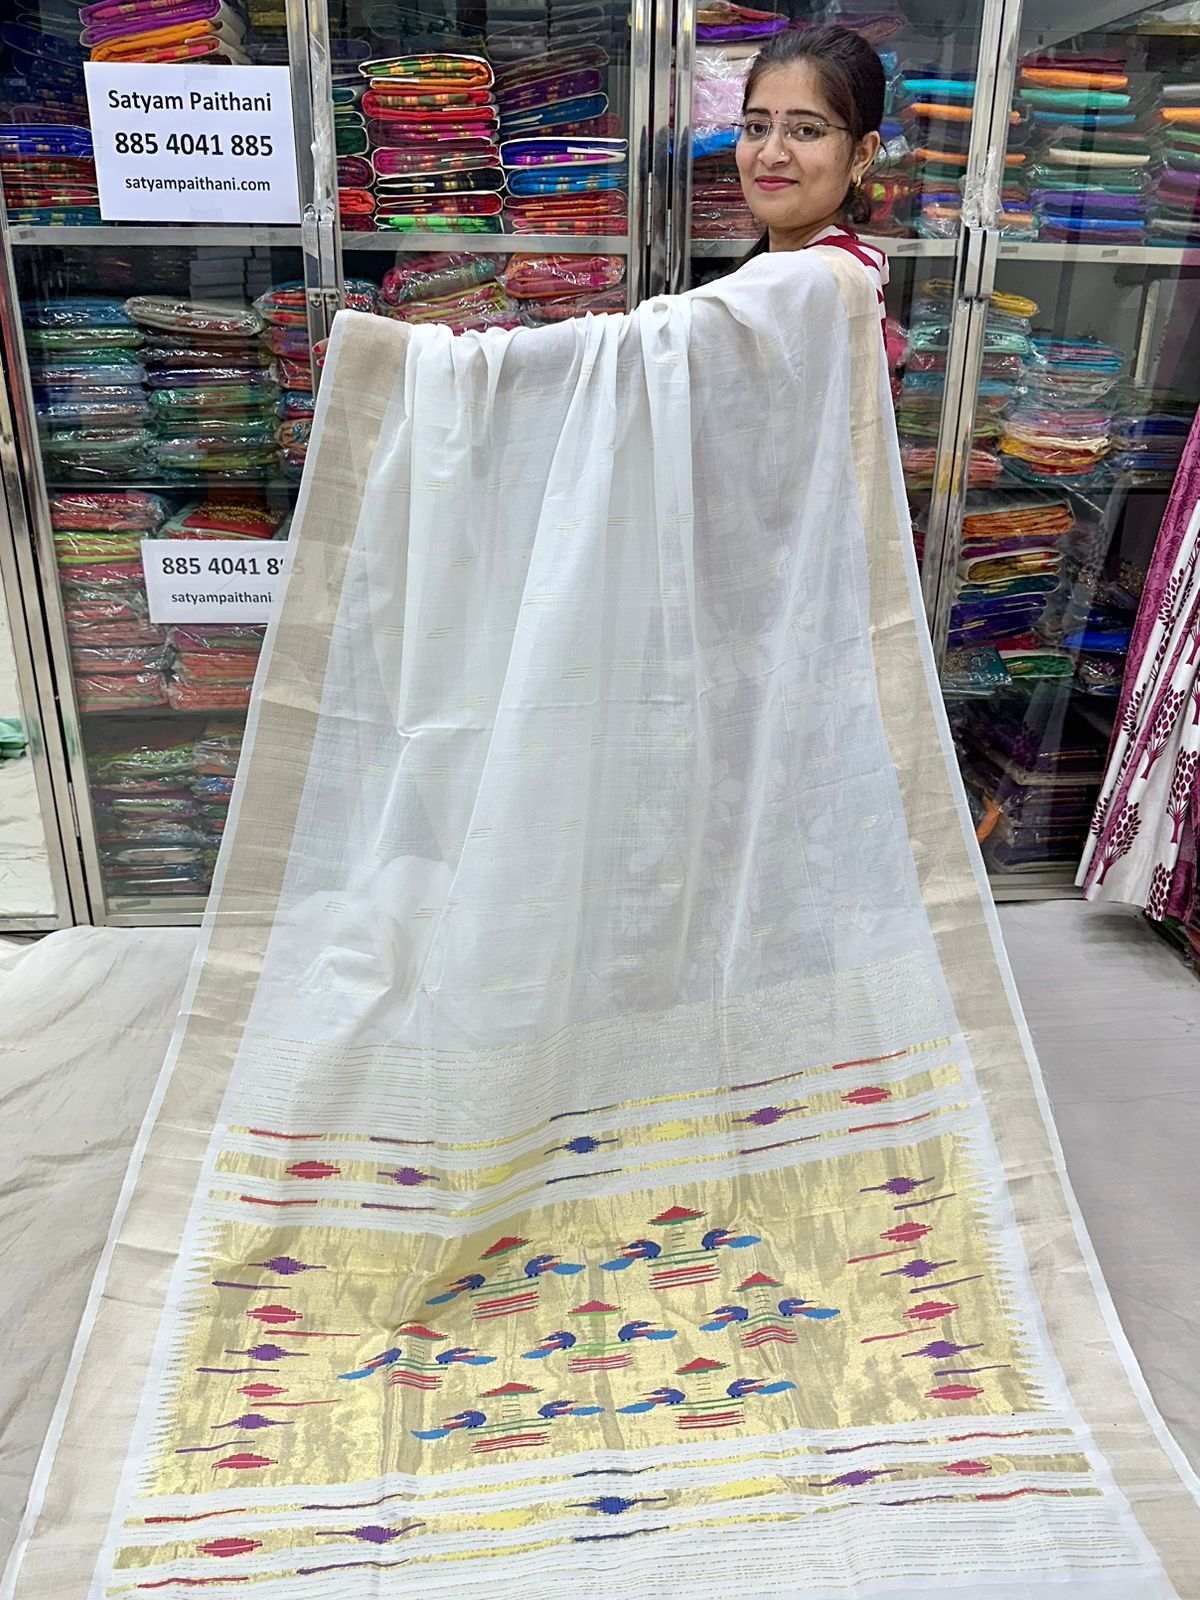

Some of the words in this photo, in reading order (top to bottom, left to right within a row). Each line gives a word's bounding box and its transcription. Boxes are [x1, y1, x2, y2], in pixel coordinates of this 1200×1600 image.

[108, 89, 184, 114] Satyam
[189, 91, 272, 112] Paithani
[115, 132, 159, 155] 885
[165, 133, 224, 156] 4041
[230, 134, 273, 157] 885
[125, 176, 271, 193] satyampaithani.com
[162, 557, 201, 576] 885
[207, 557, 261, 576] 4041
